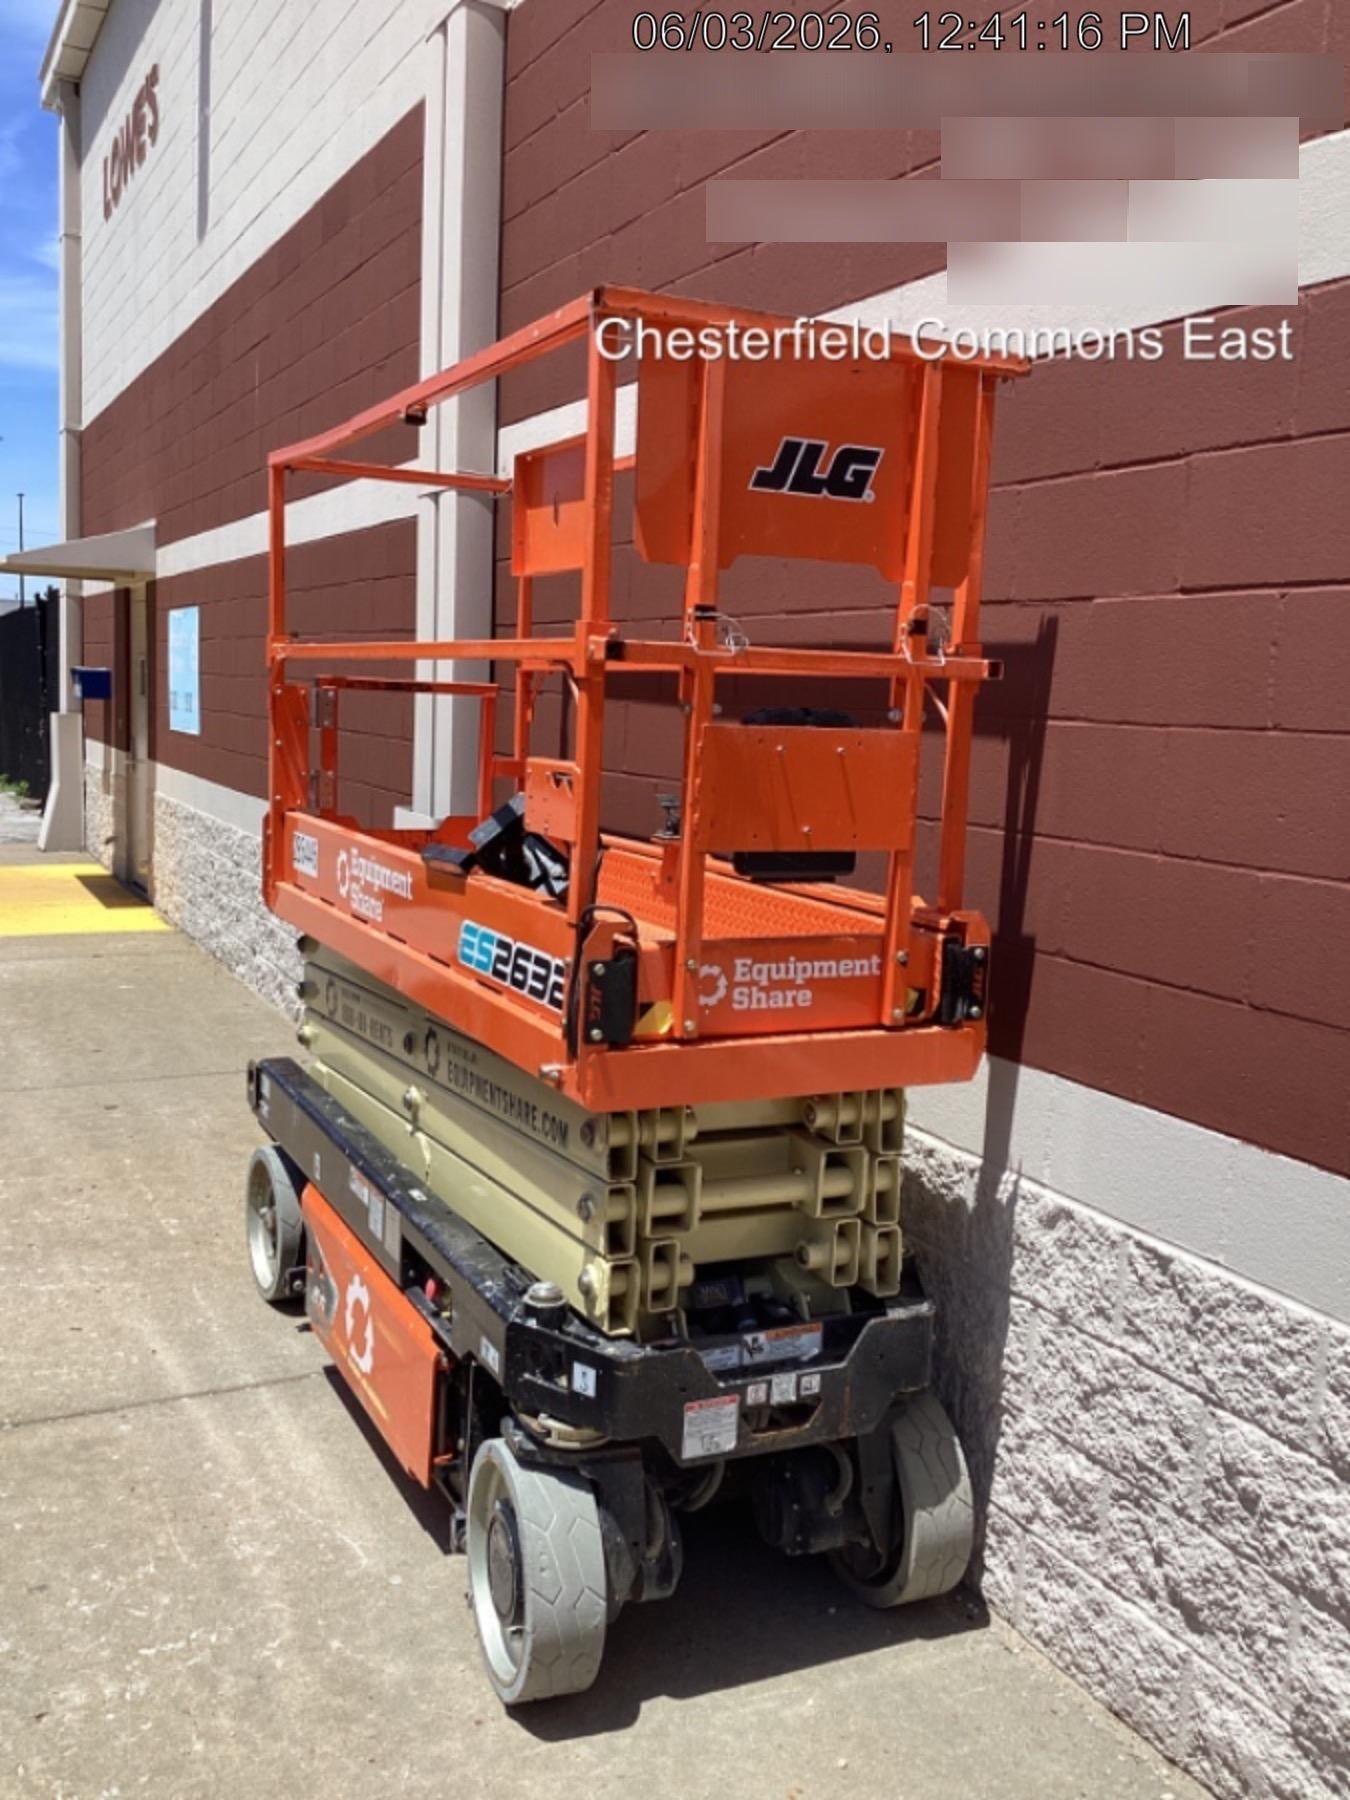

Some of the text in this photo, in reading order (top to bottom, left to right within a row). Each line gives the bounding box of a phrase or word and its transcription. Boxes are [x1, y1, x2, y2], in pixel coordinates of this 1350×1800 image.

[750, 437, 884, 502] JLG
[351, 848, 412, 900] Equipment
[351, 883, 384, 922] Share
[459, 921, 565, 1012] ES2632
[734, 955, 881, 986] Equipment
[731, 986, 813, 1010] Share
[448, 1060, 569, 1147] EQUIPMENTSHARE.COM
